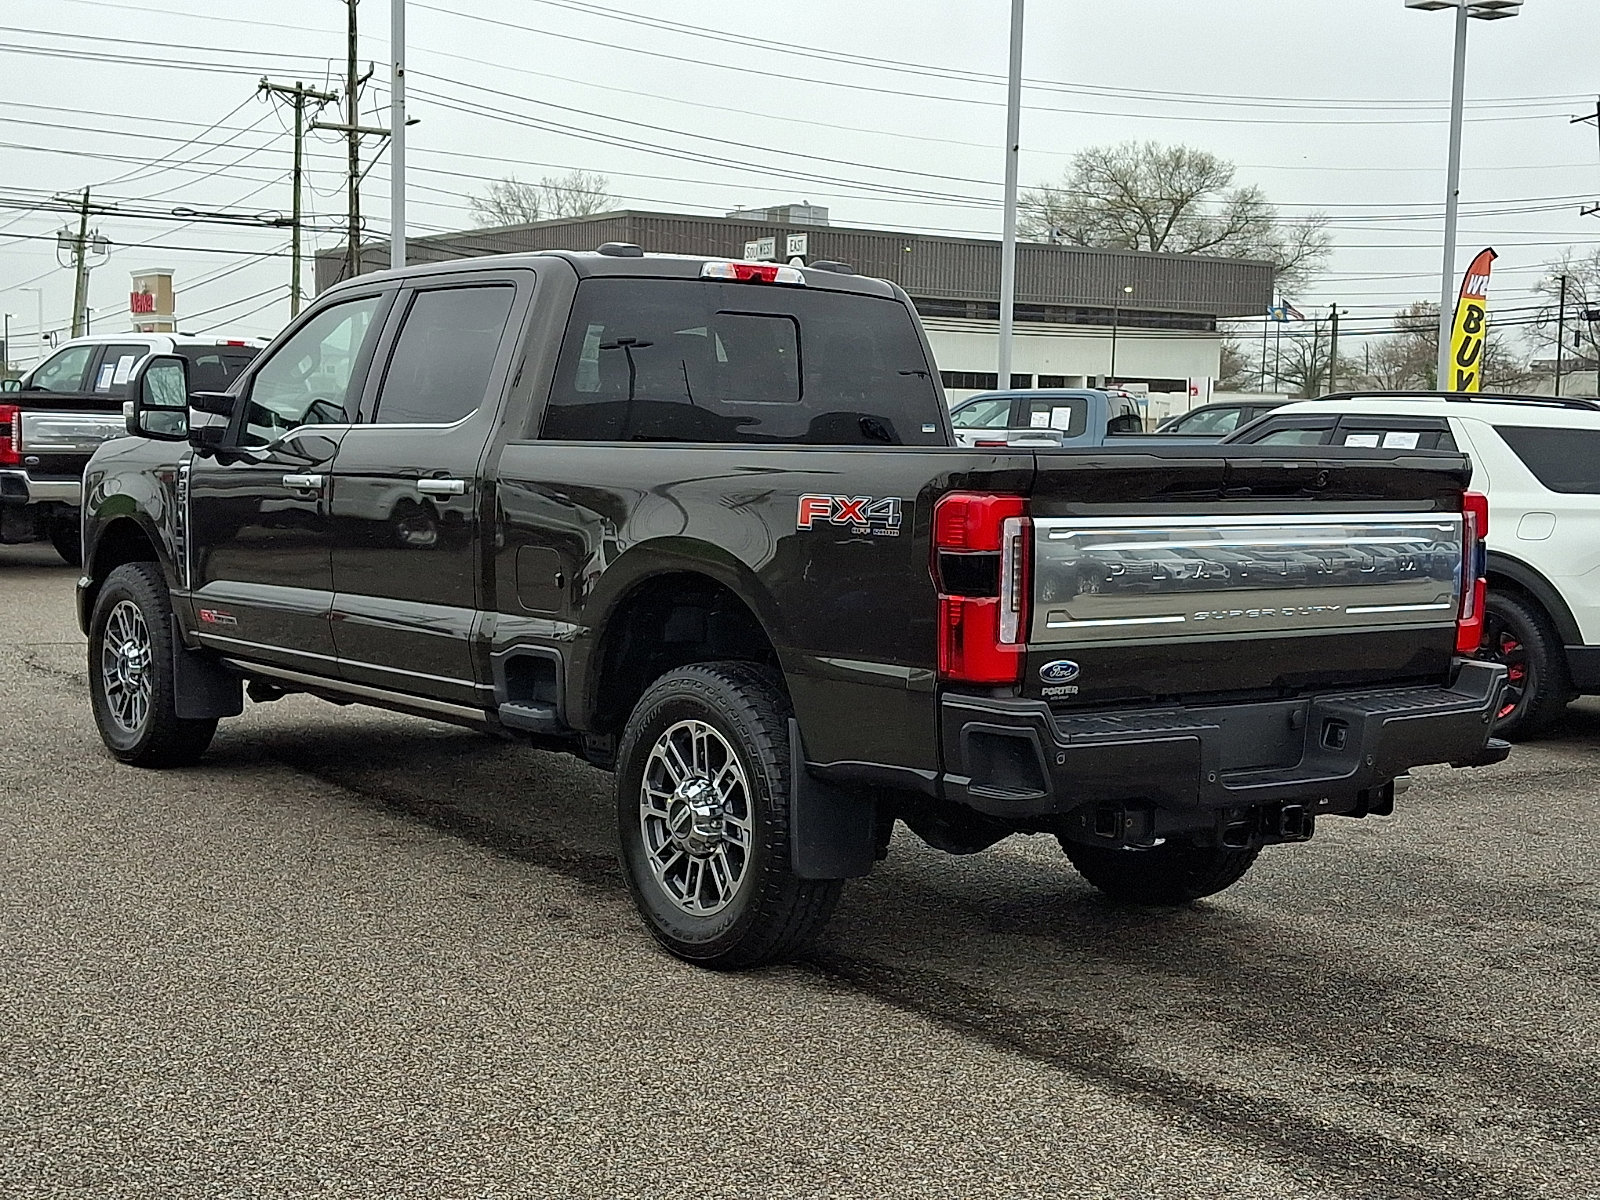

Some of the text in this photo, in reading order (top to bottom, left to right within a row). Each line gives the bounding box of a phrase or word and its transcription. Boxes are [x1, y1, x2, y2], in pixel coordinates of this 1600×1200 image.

[790, 240, 804, 253] EAST
[1467, 273, 1489, 296] WE
[1456, 303, 1485, 392] BUY
[797, 493, 902, 531] FX4
[1105, 556, 1417, 582] PLATINUM
[1193, 604, 1341, 621] SUPER DUTY
[1049, 665, 1073, 678] Ford
[1041, 685, 1079, 696] PORTER
